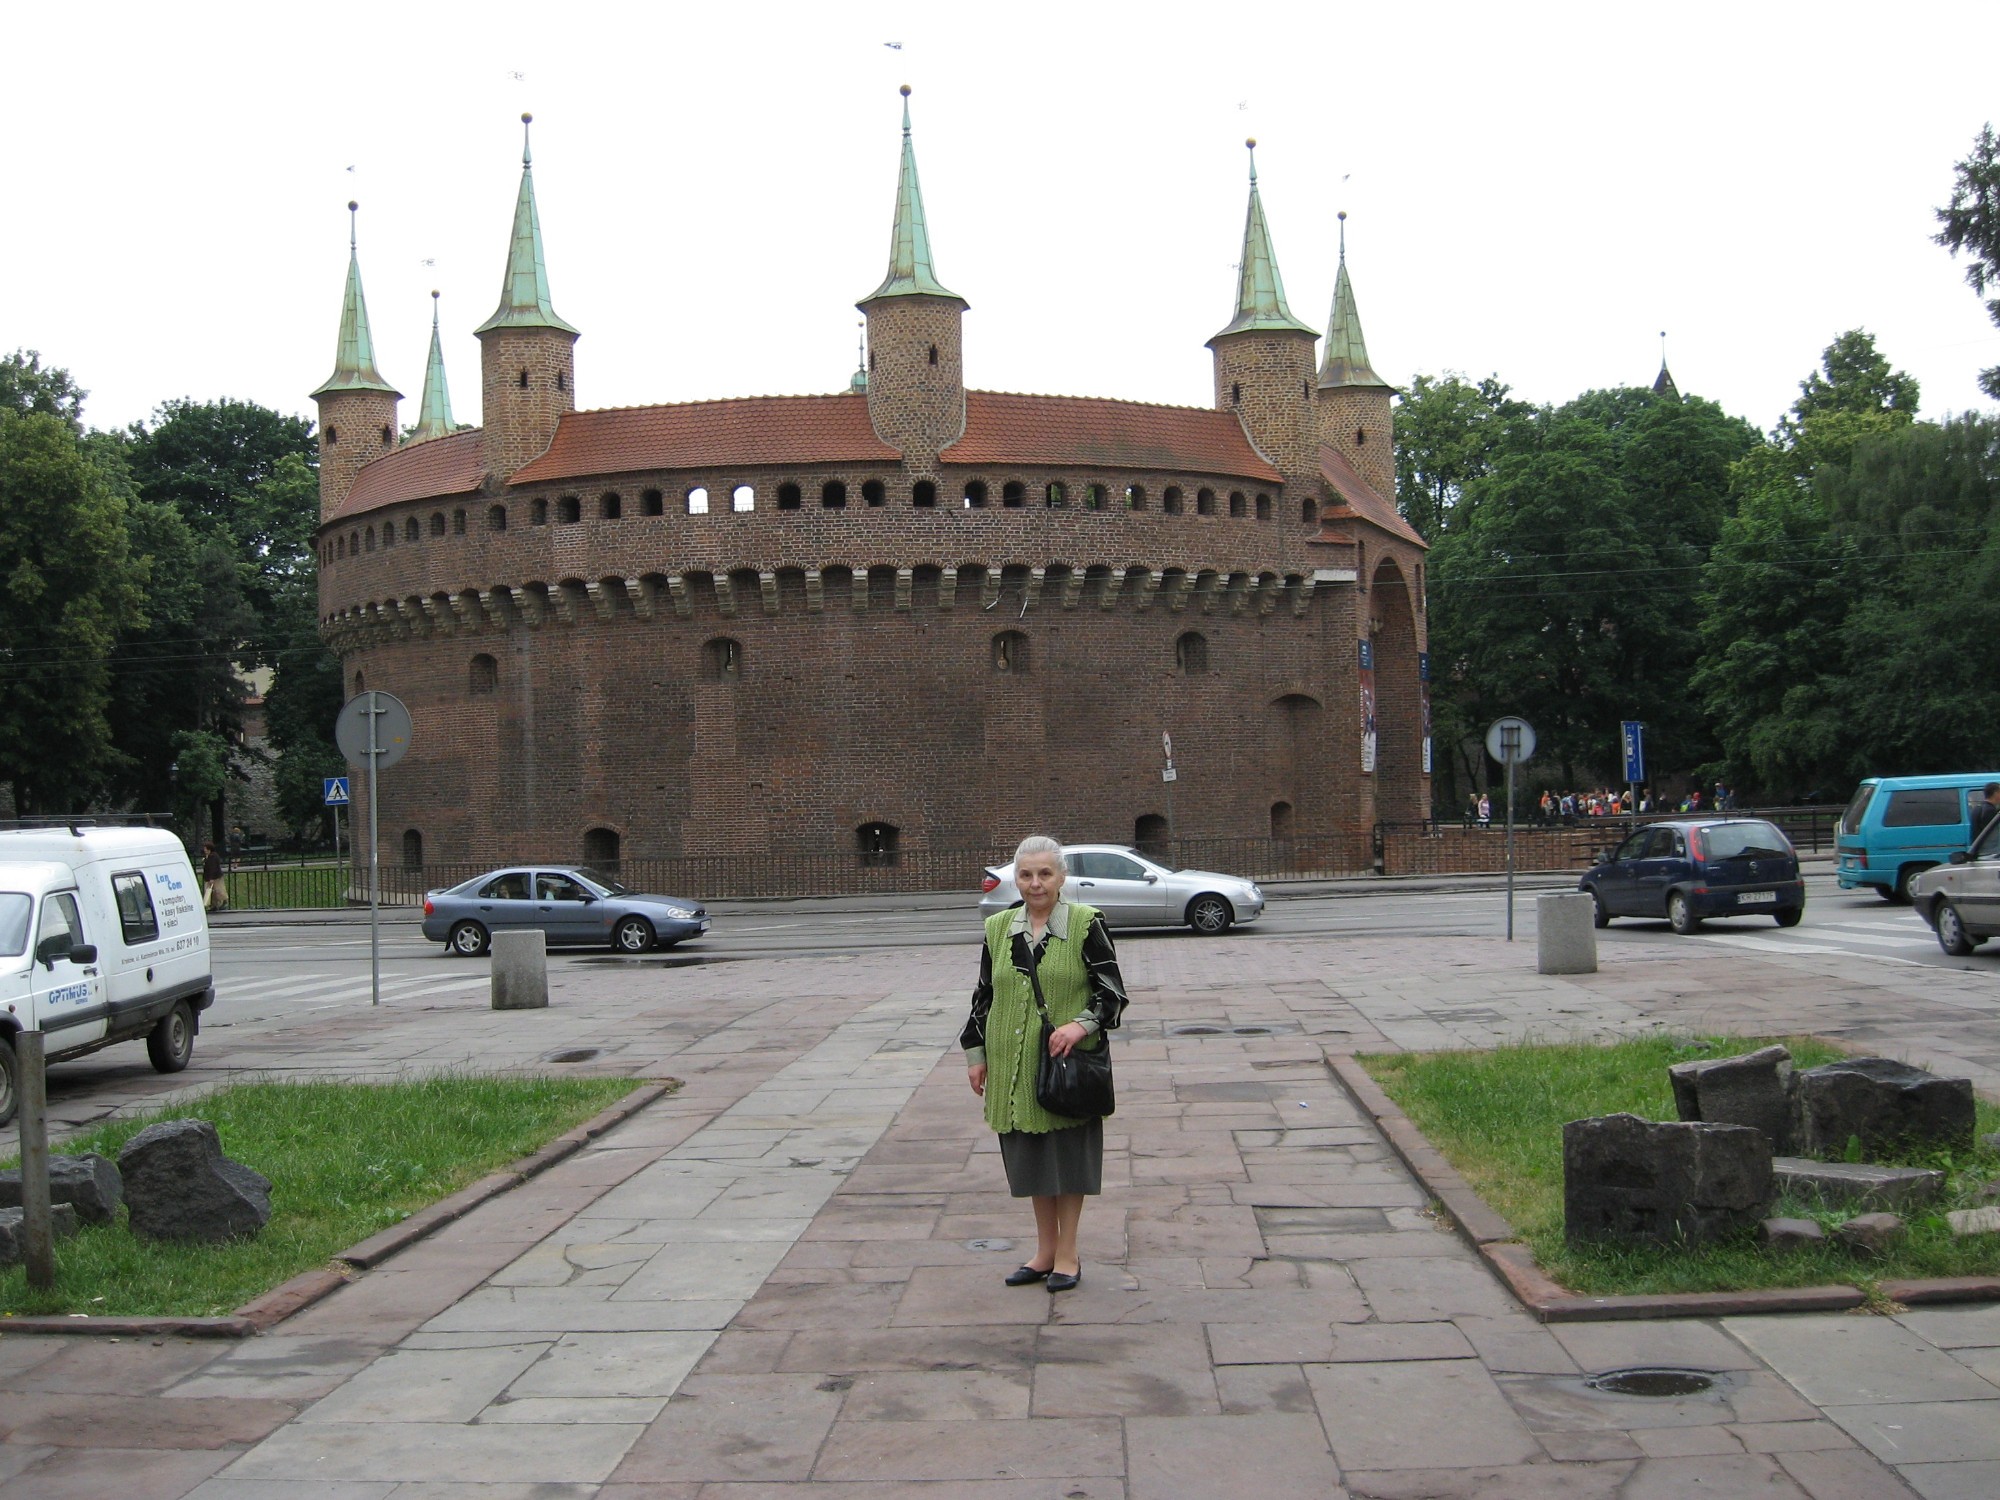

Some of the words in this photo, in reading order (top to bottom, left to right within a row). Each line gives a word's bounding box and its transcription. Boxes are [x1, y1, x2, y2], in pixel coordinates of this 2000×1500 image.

[156, 873, 169, 884] Lan
[168, 881, 182, 890] Com
[49, 984, 88, 1004] OPTIMUS
